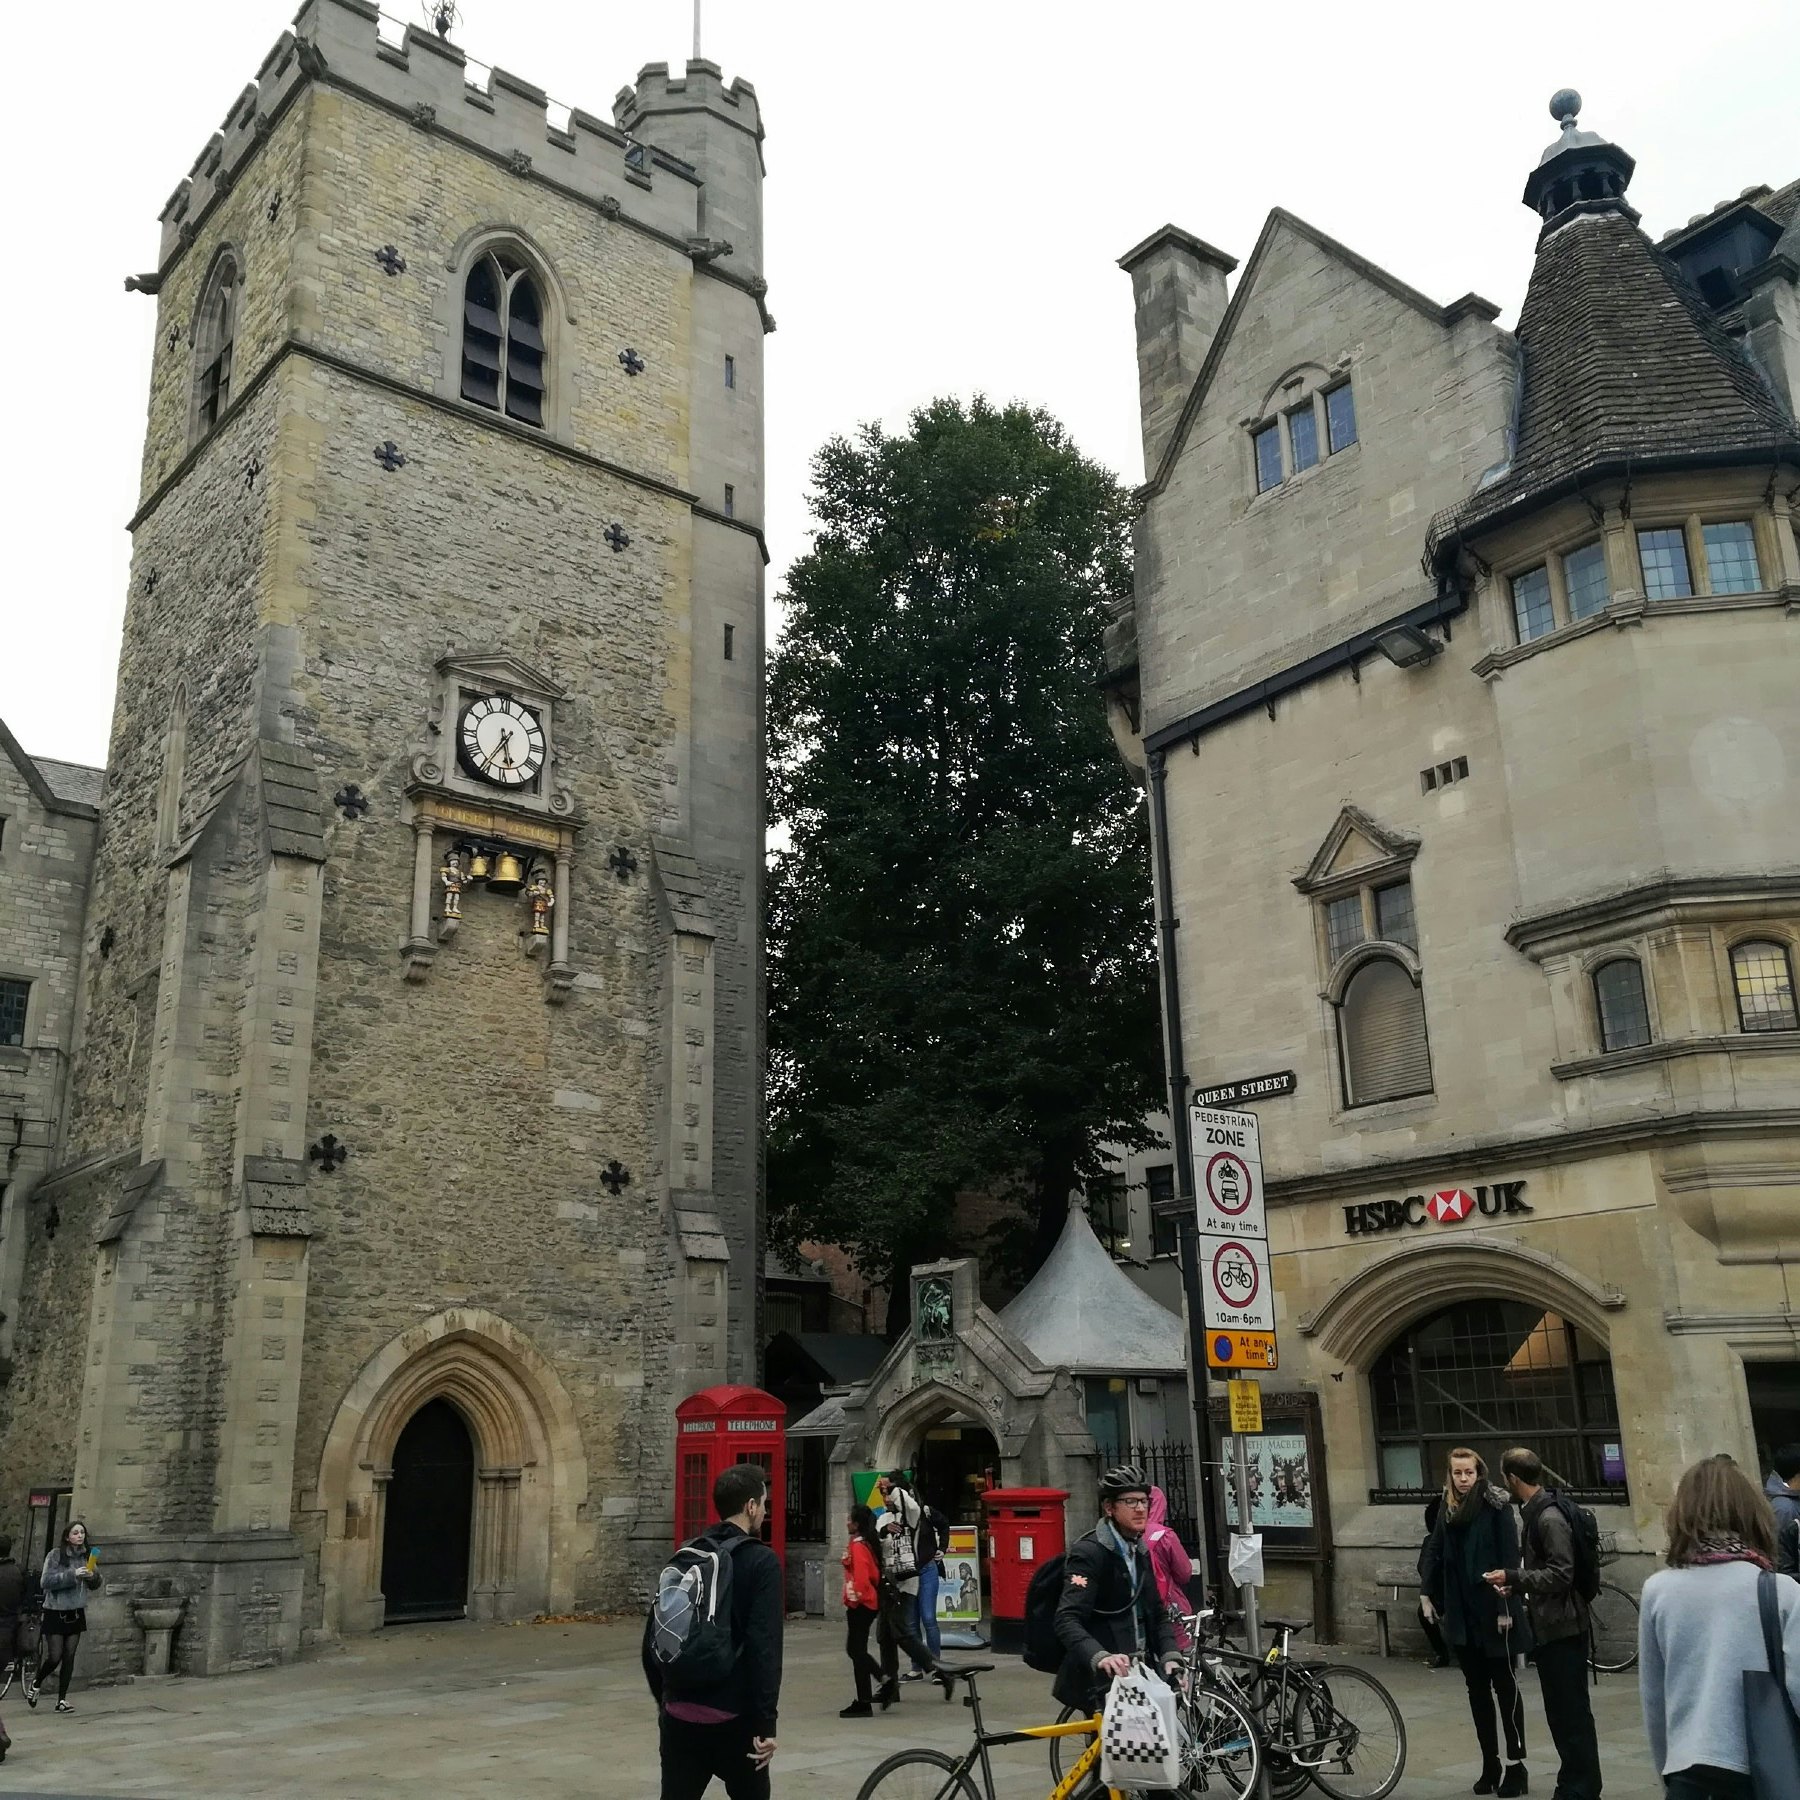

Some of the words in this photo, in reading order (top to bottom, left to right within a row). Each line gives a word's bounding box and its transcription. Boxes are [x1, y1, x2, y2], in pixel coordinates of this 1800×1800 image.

[1197, 1087, 1236, 1106] QUEEN
[1241, 1075, 1289, 1096] STREET
[1195, 1111, 1254, 1128] PEDESTRIAN
[1206, 1128, 1245, 1147] ZONE
[1342, 1195, 1426, 1234] HSBC
[1473, 1180, 1534, 1216] UK
[1207, 1217, 1217, 1229] At
[1220, 1221, 1236, 1232] any
[1239, 1220, 1258, 1232] time
[1216, 1312, 1262, 1325] 10am-6pm
[1240, 1337, 1250, 1347] At
[1253, 1339, 1268, 1350] any
[1246, 1350, 1265, 1360] time
[730, 1420, 775, 1431] TELEPHONE
